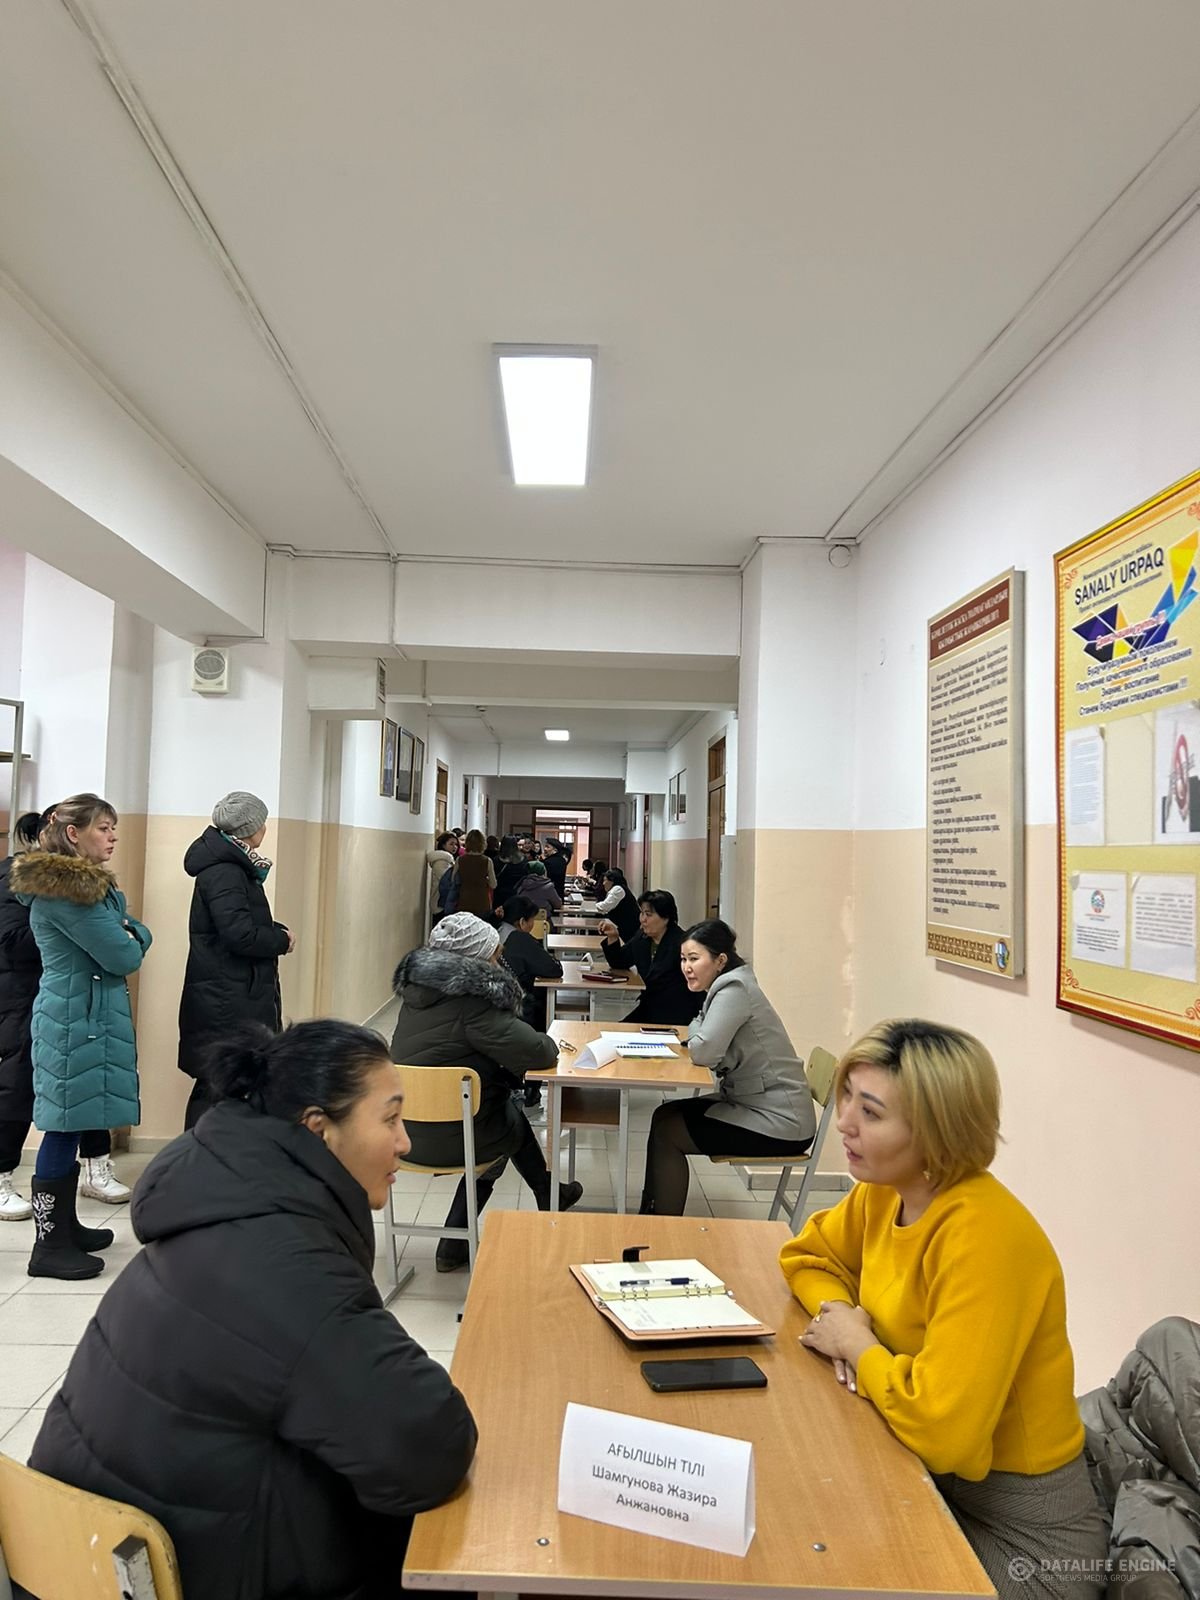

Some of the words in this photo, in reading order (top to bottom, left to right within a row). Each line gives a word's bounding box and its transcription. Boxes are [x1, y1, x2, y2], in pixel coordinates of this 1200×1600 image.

[1075, 569, 1117, 605] SANALY
[1120, 547, 1164, 583] URPAQ
[1076, 677, 1105, 691] Получение
[1106, 663, 1148, 681] качественного
[1149, 648, 1192, 669] образования
[1124, 673, 1160, 690] воспитание
[1080, 705, 1099, 715] Станем
[1100, 697, 1129, 712] будущими
[1130, 683, 1178, 702] специалистами
[607, 1442, 677, 1470] АҒЫЛШЫН
[680, 1459, 705, 1477] ТІЛІ
[592, 1464, 664, 1494] Шамгунова
[667, 1483, 717, 1507] Жазира
[616, 1493, 690, 1522] Анжановна
